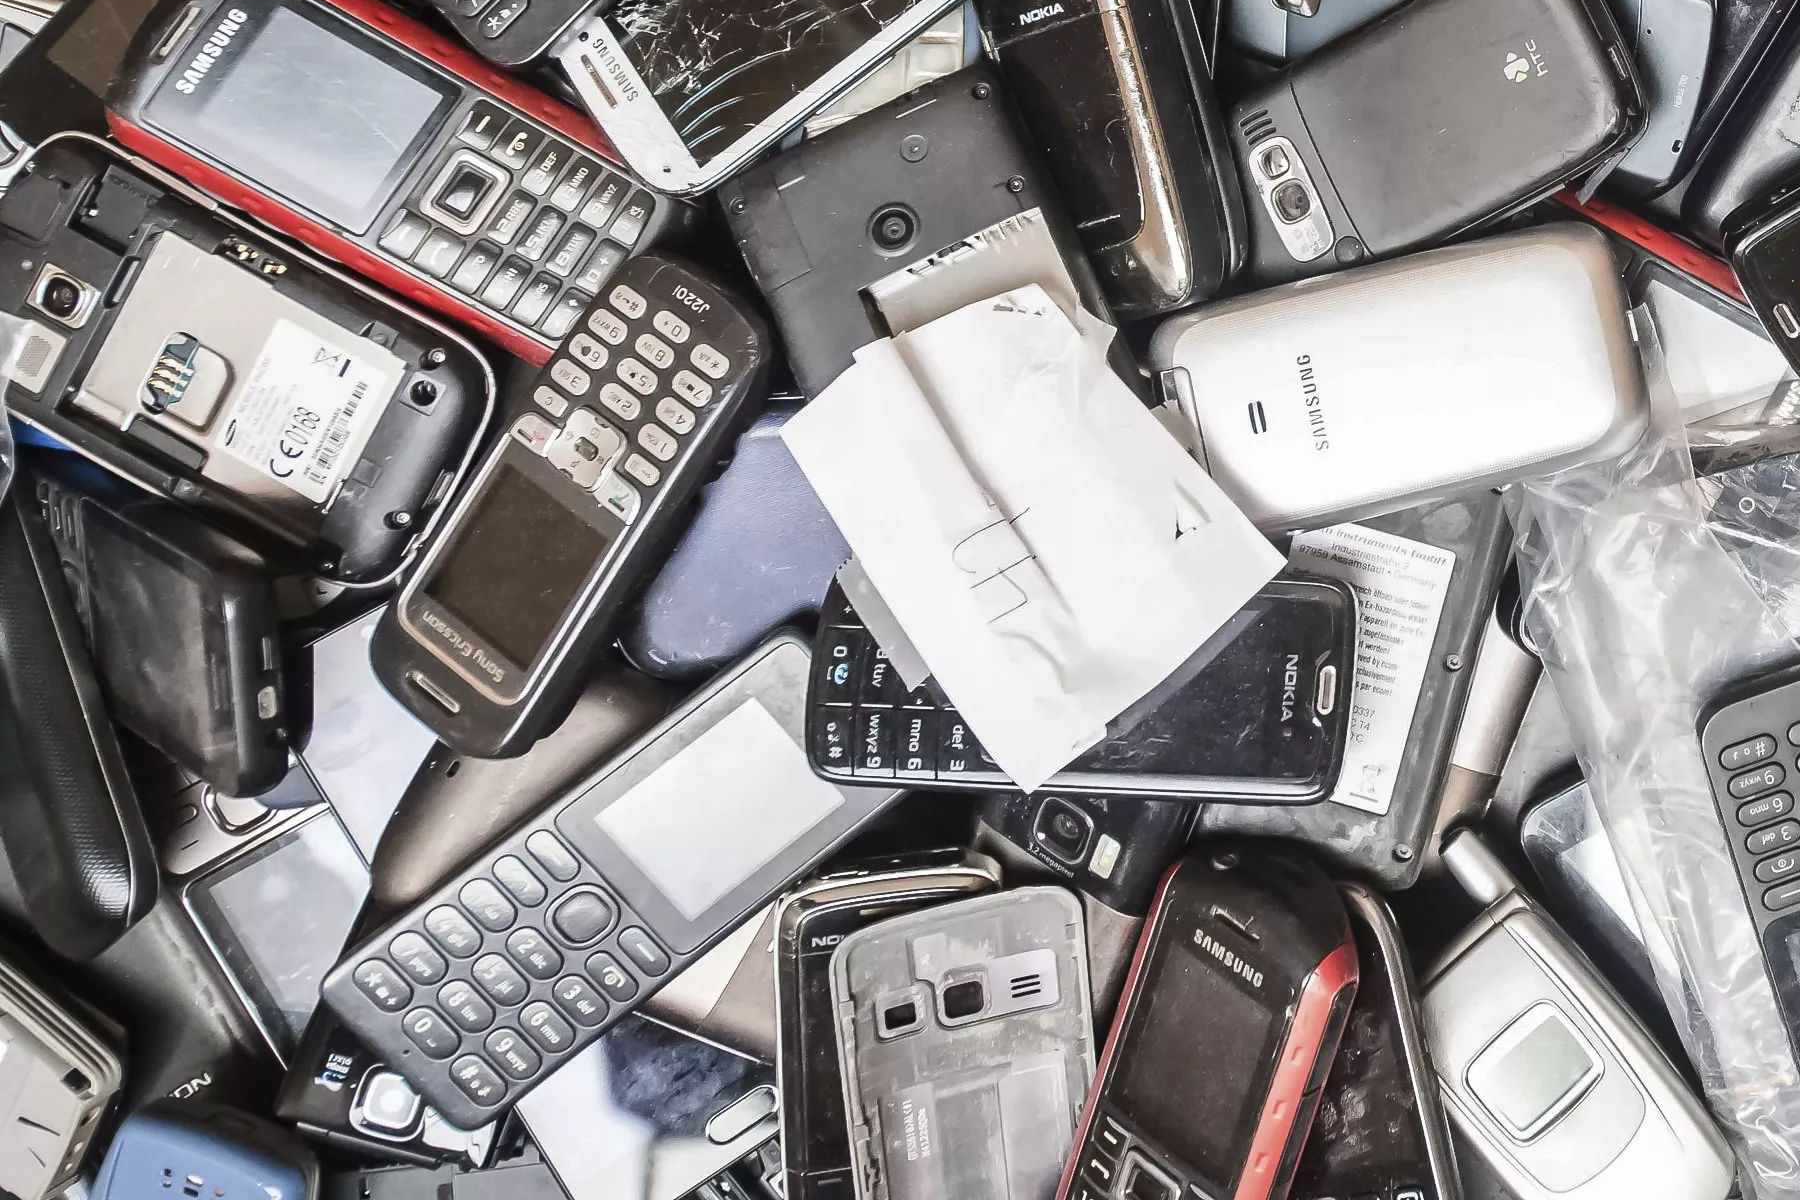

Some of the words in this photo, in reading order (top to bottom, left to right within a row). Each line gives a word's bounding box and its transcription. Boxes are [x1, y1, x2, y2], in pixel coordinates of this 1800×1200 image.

[1019, 2, 1064, 26] NOKIA
[174, 8, 249, 95] SAMSUNG
[592, 38, 639, 102] SAMSUNG
[1296, 354, 1329, 451] SAMSUNG
[422, 610, 474, 657] Ericsson
[471, 648, 505, 683] Sony
[1281, 654, 1299, 722] NOKIA
[1027, 842, 1040, 855] 3.2
[1193, 928, 1264, 988] SAMSUNG
